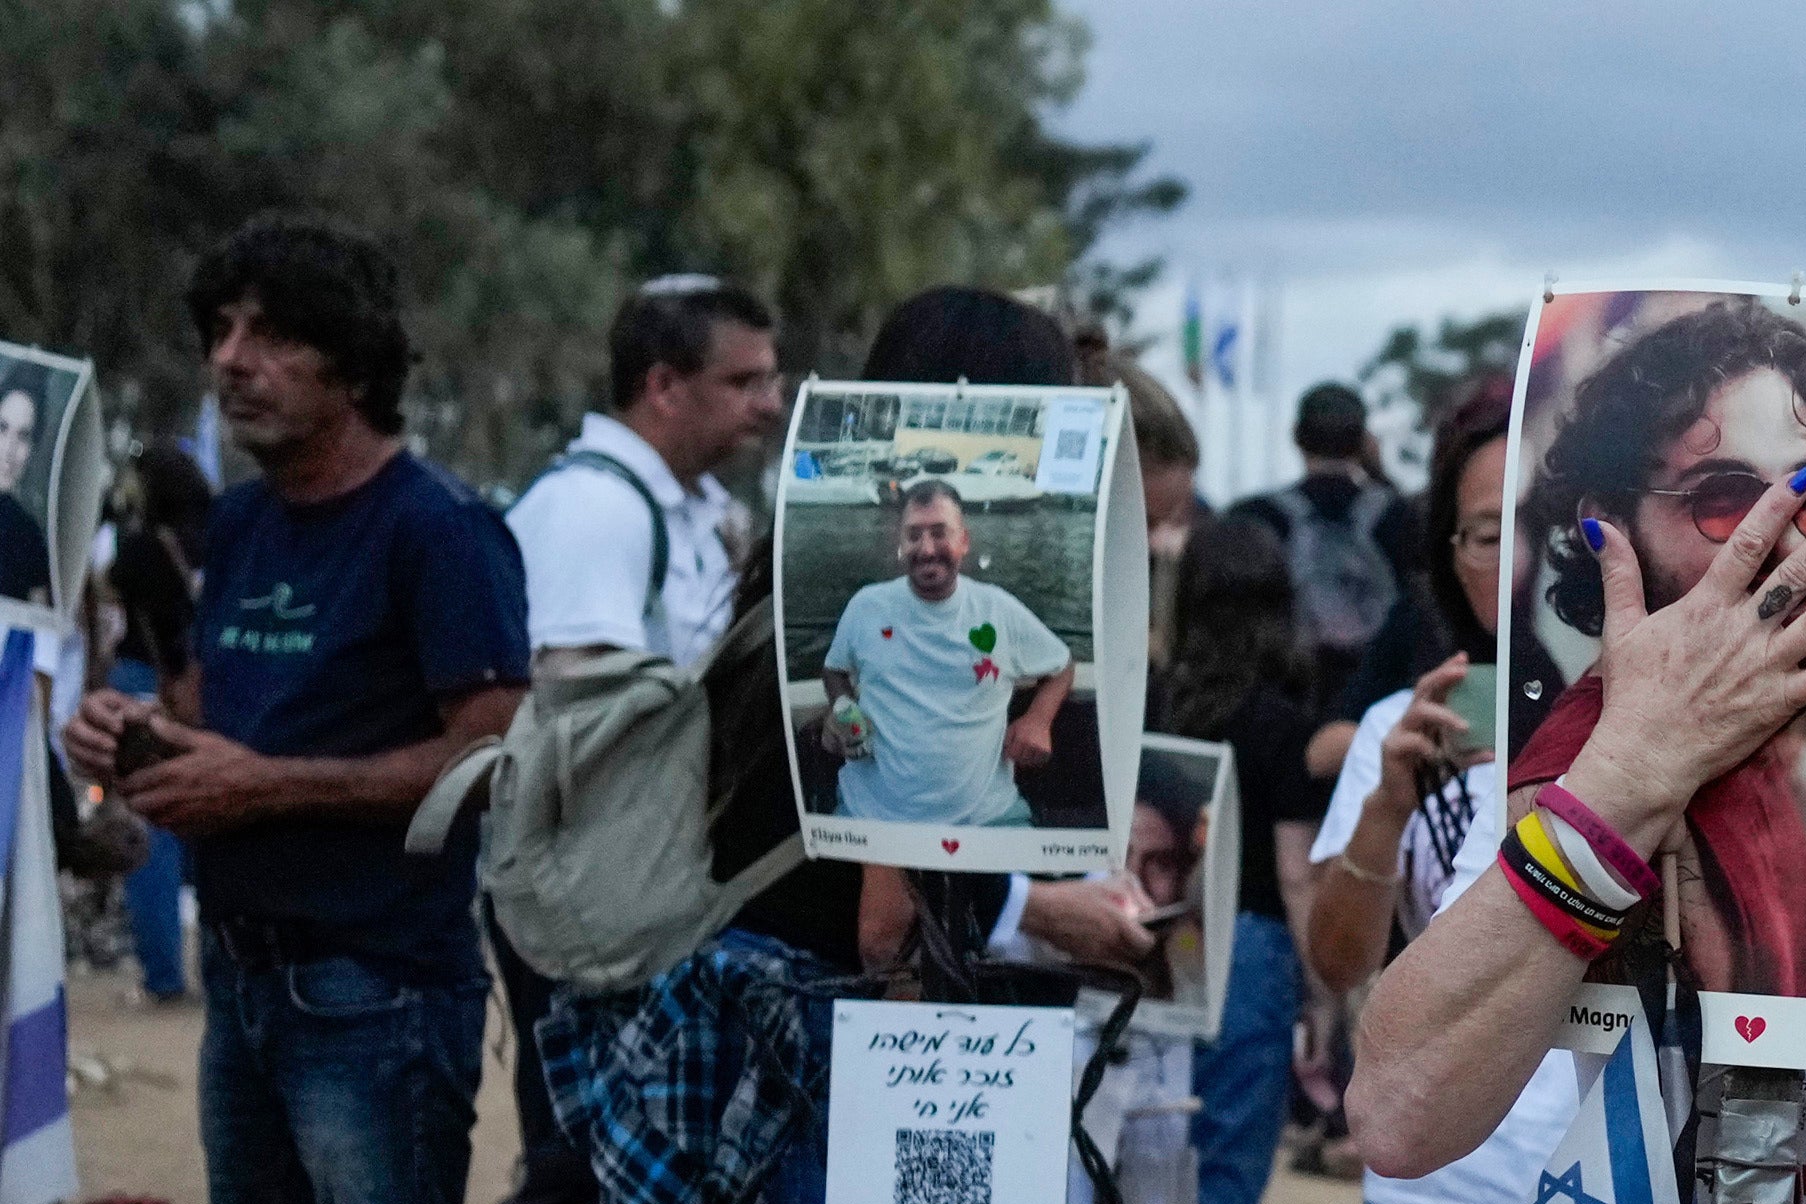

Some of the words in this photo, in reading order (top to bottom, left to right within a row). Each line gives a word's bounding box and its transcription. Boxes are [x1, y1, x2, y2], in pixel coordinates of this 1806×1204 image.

[1570, 1006, 1635, 1032] Magn
[869, 1030, 949, 1054] מישהו
[956, 1033, 999, 1055] עוד
[1004, 1018, 1035, 1056] כל
[886, 1058, 947, 1088] אותי
[958, 1068, 1014, 1088] זוכר
[914, 1099, 938, 1118] חי
[948, 1092, 990, 1124] אני
